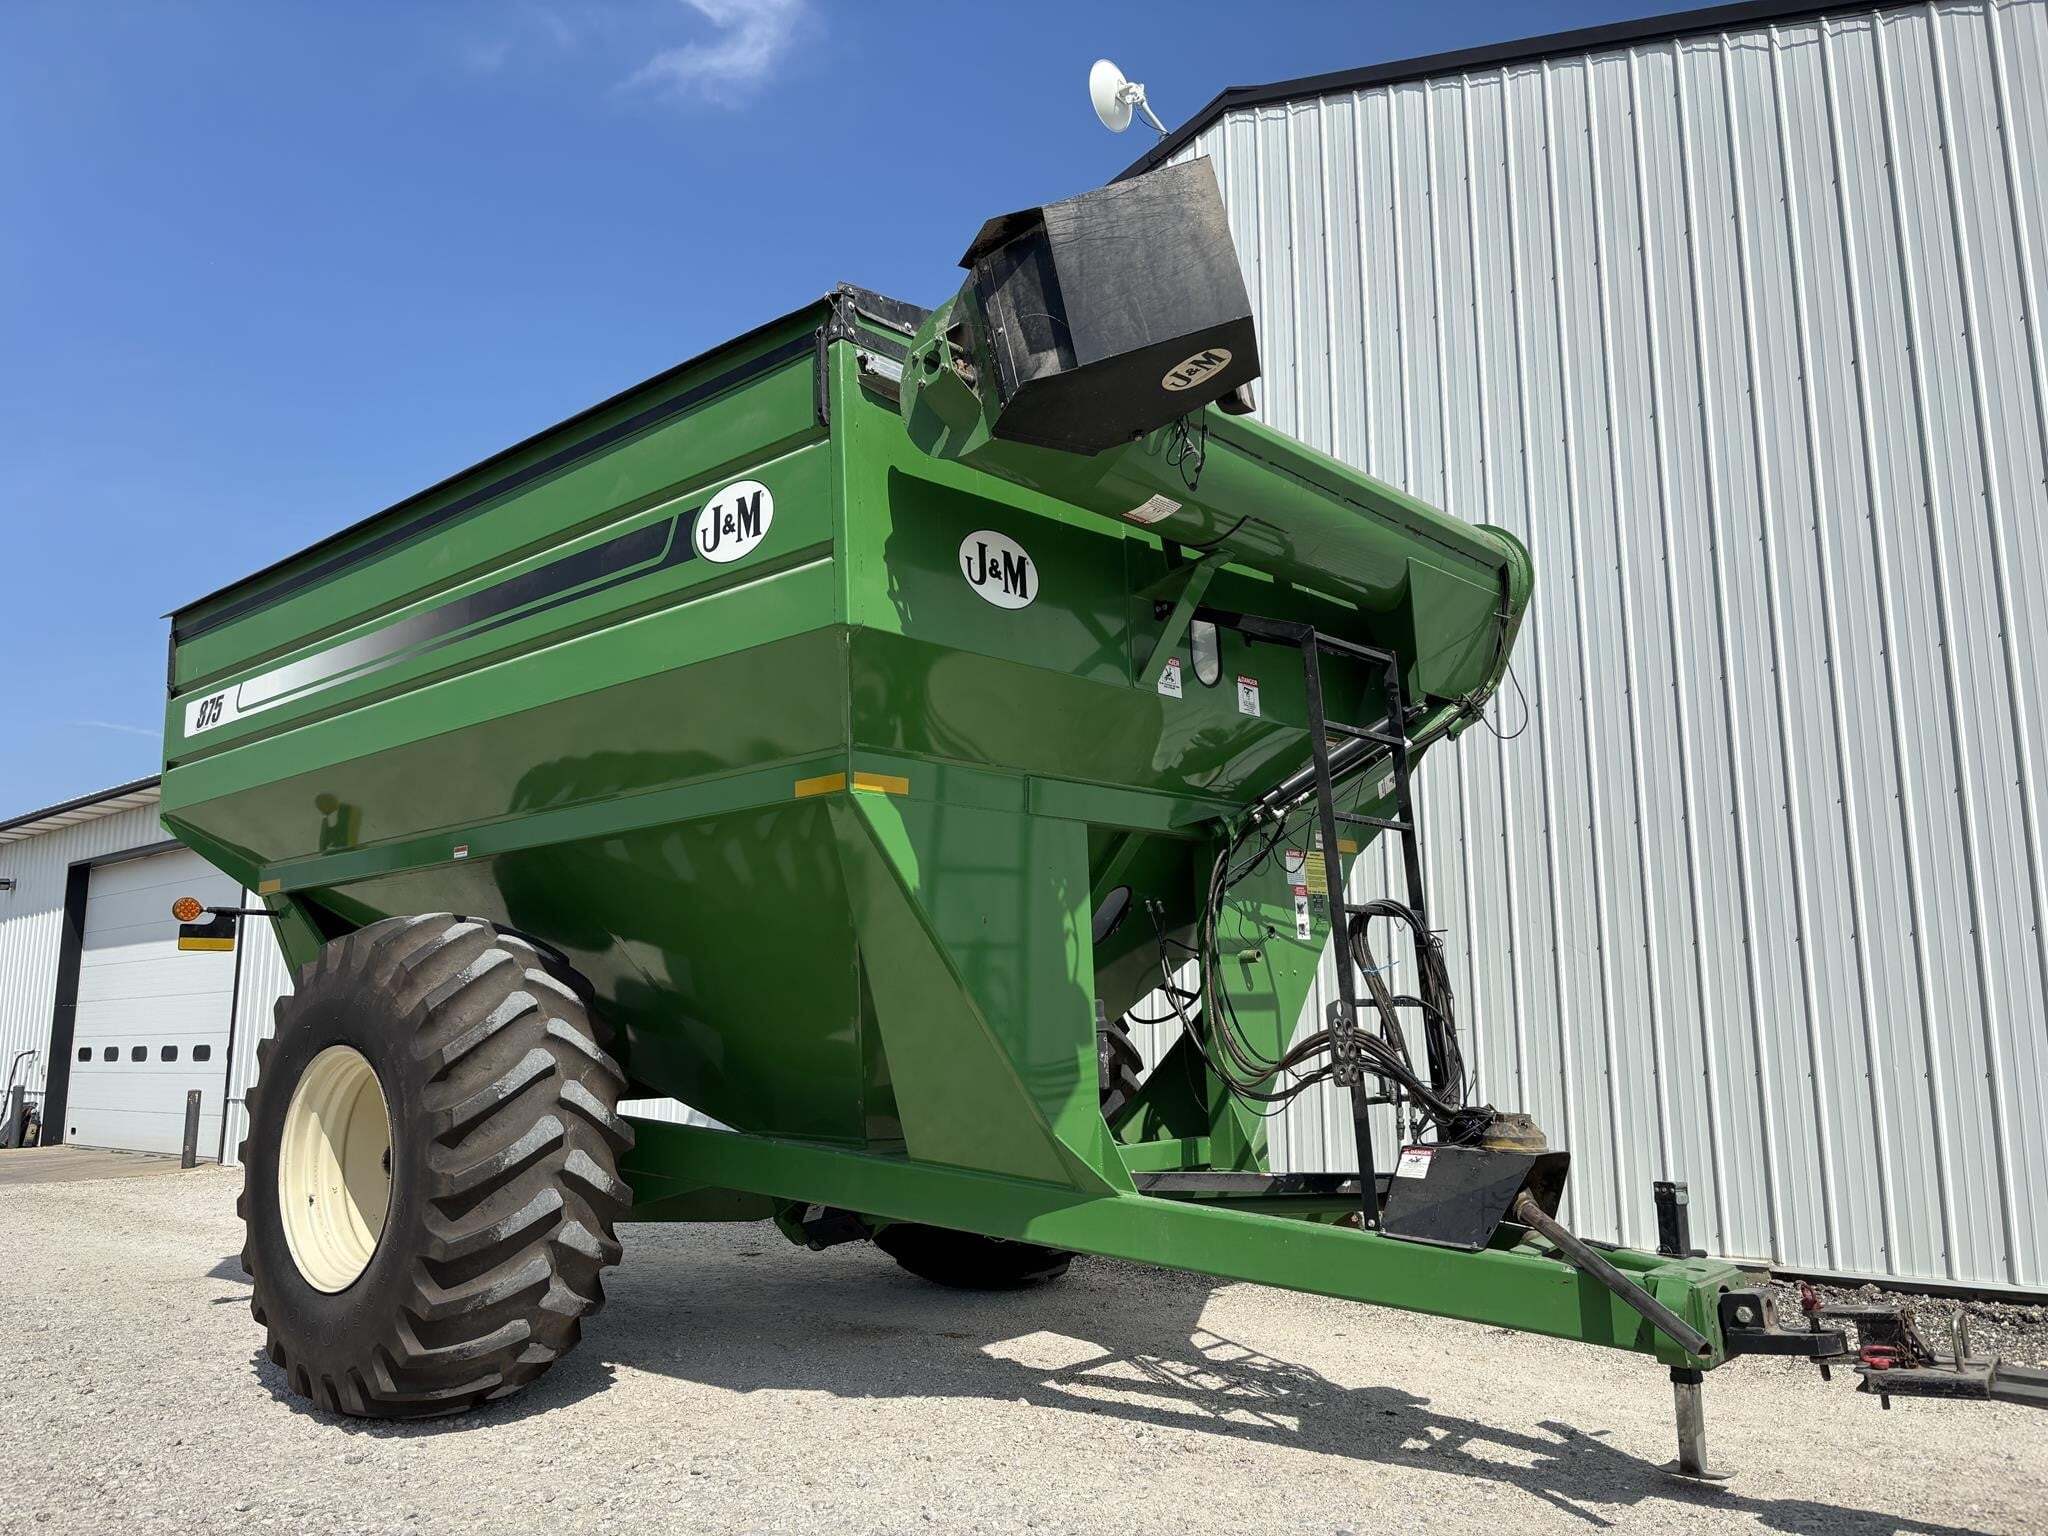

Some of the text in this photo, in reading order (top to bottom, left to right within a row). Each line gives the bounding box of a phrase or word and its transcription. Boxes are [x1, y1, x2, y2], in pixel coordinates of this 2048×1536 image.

[1169, 351, 1227, 387] J&M
[701, 489, 762, 553] J&M
[965, 541, 1028, 600] J&M
[196, 694, 225, 729] 875
